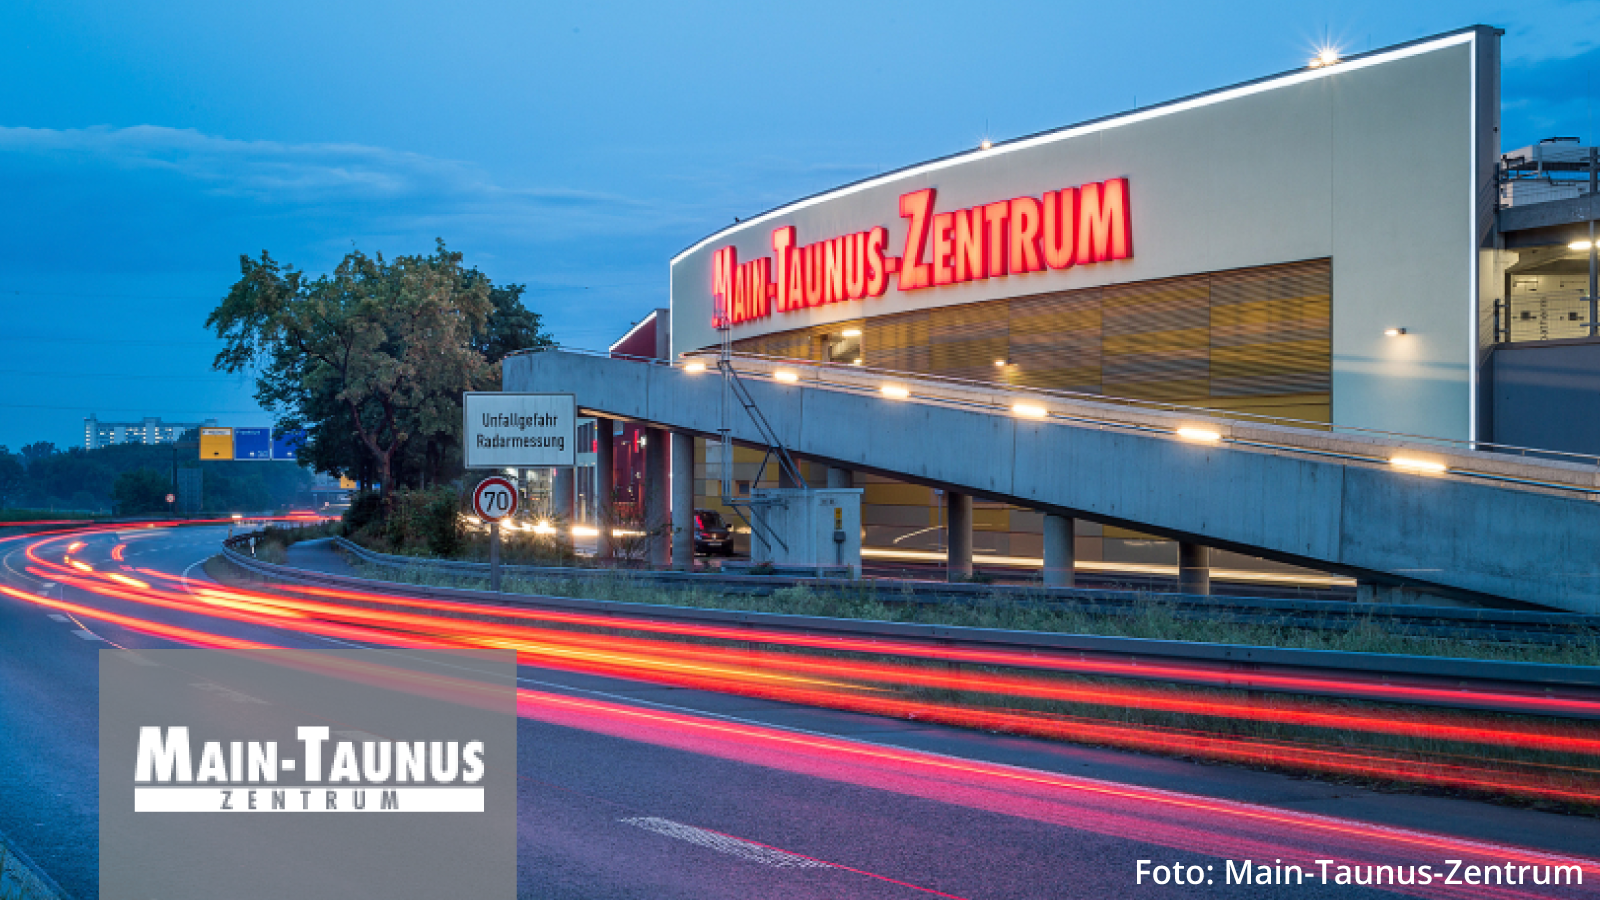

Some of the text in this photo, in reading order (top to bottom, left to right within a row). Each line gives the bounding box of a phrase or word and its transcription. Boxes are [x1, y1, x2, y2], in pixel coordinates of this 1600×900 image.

[482, 412, 559, 431] Unfallgefahr
[476, 434, 565, 451] Radarmessung
[484, 491, 509, 512] 70
